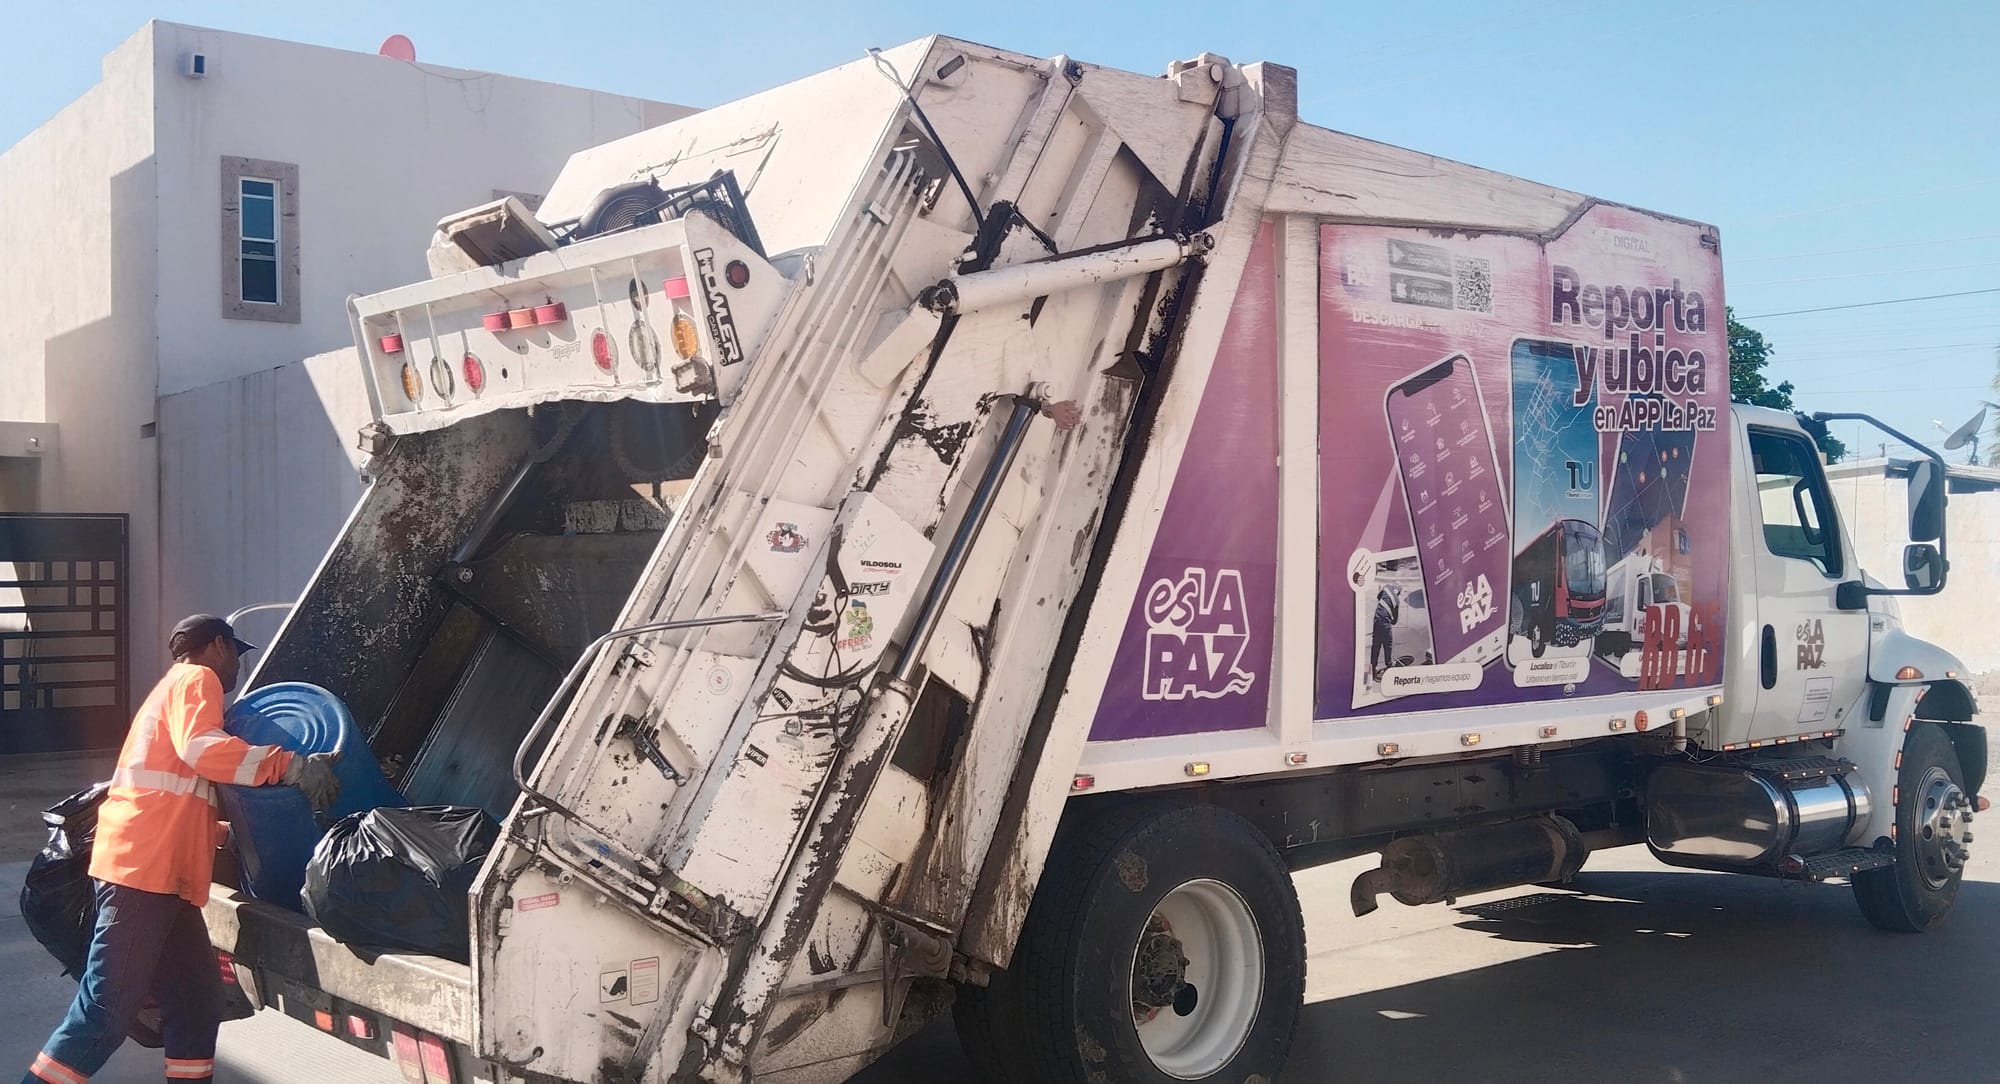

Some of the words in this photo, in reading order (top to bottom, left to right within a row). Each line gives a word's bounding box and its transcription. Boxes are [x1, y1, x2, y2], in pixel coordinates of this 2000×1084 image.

[1613, 235, 1650, 252] DIGITAL
[1411, 290, 1428, 304] App
[1429, 291, 1450, 306] Store
[1551, 264, 1707, 340] Reporta
[1352, 309, 1422, 330] DESCARGA
[1573, 345, 1599, 406] y
[1604, 332, 1707, 394] ubica
[1594, 406, 1616, 431] en
[1618, 399, 1661, 430] APP
[1663, 399, 1683, 431] La
[1685, 400, 1716, 431] Paz
[850, 582, 890, 595] DIRTY
[1460, 594, 1498, 635] PAZ
[1143, 631, 1255, 700] PAZ
[1797, 644, 1827, 670] PAZ
[1393, 675, 1420, 687] Reporta
[772, 688, 791, 709] VIPER
[747, 747, 768, 765] VIPER
